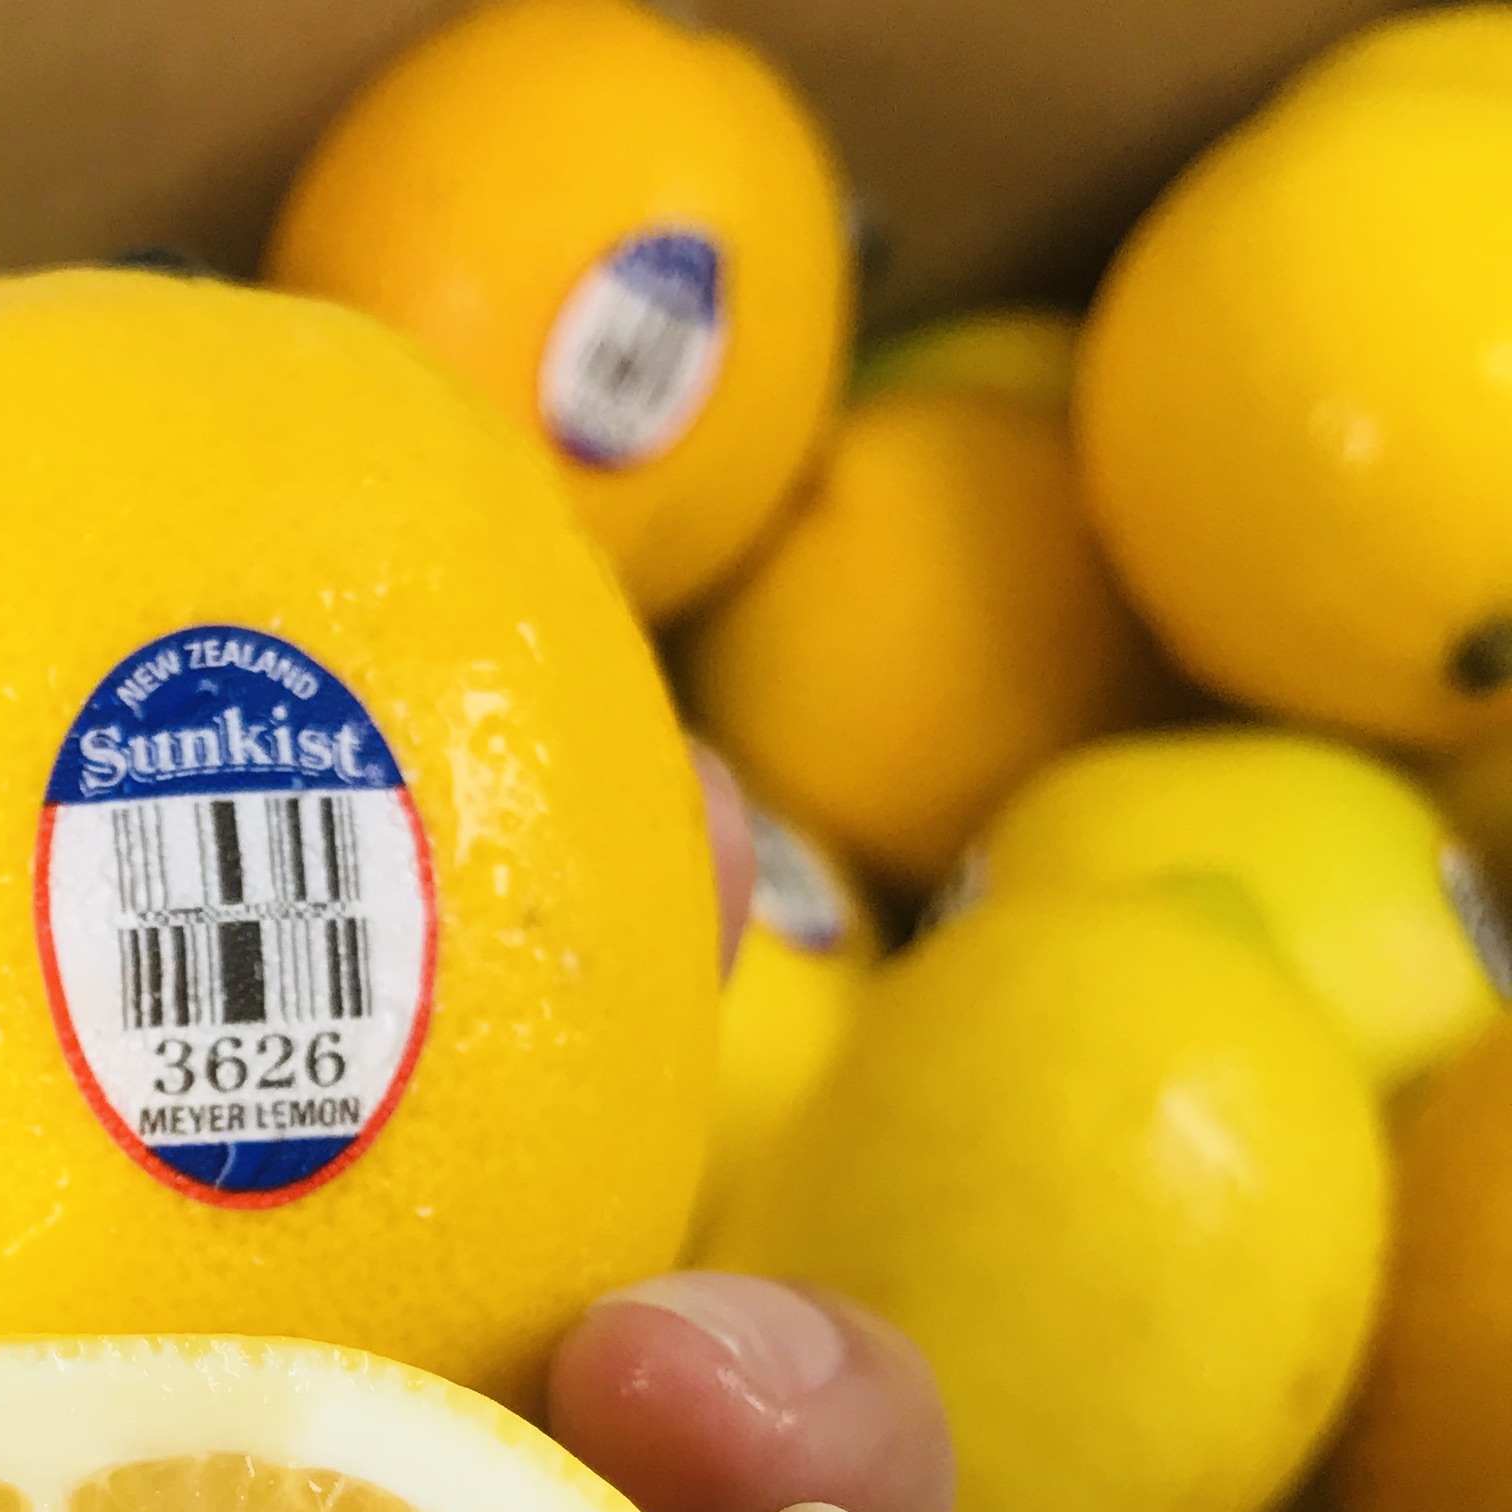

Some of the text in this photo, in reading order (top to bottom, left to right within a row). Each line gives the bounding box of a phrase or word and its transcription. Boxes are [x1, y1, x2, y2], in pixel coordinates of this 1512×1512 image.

[116, 638, 319, 718] NEW ZEALAND
[79, 702, 365, 795] Sunkist
[154, 1031, 346, 1096] 3626
[139, 1096, 361, 1137] MEYER LEMON
